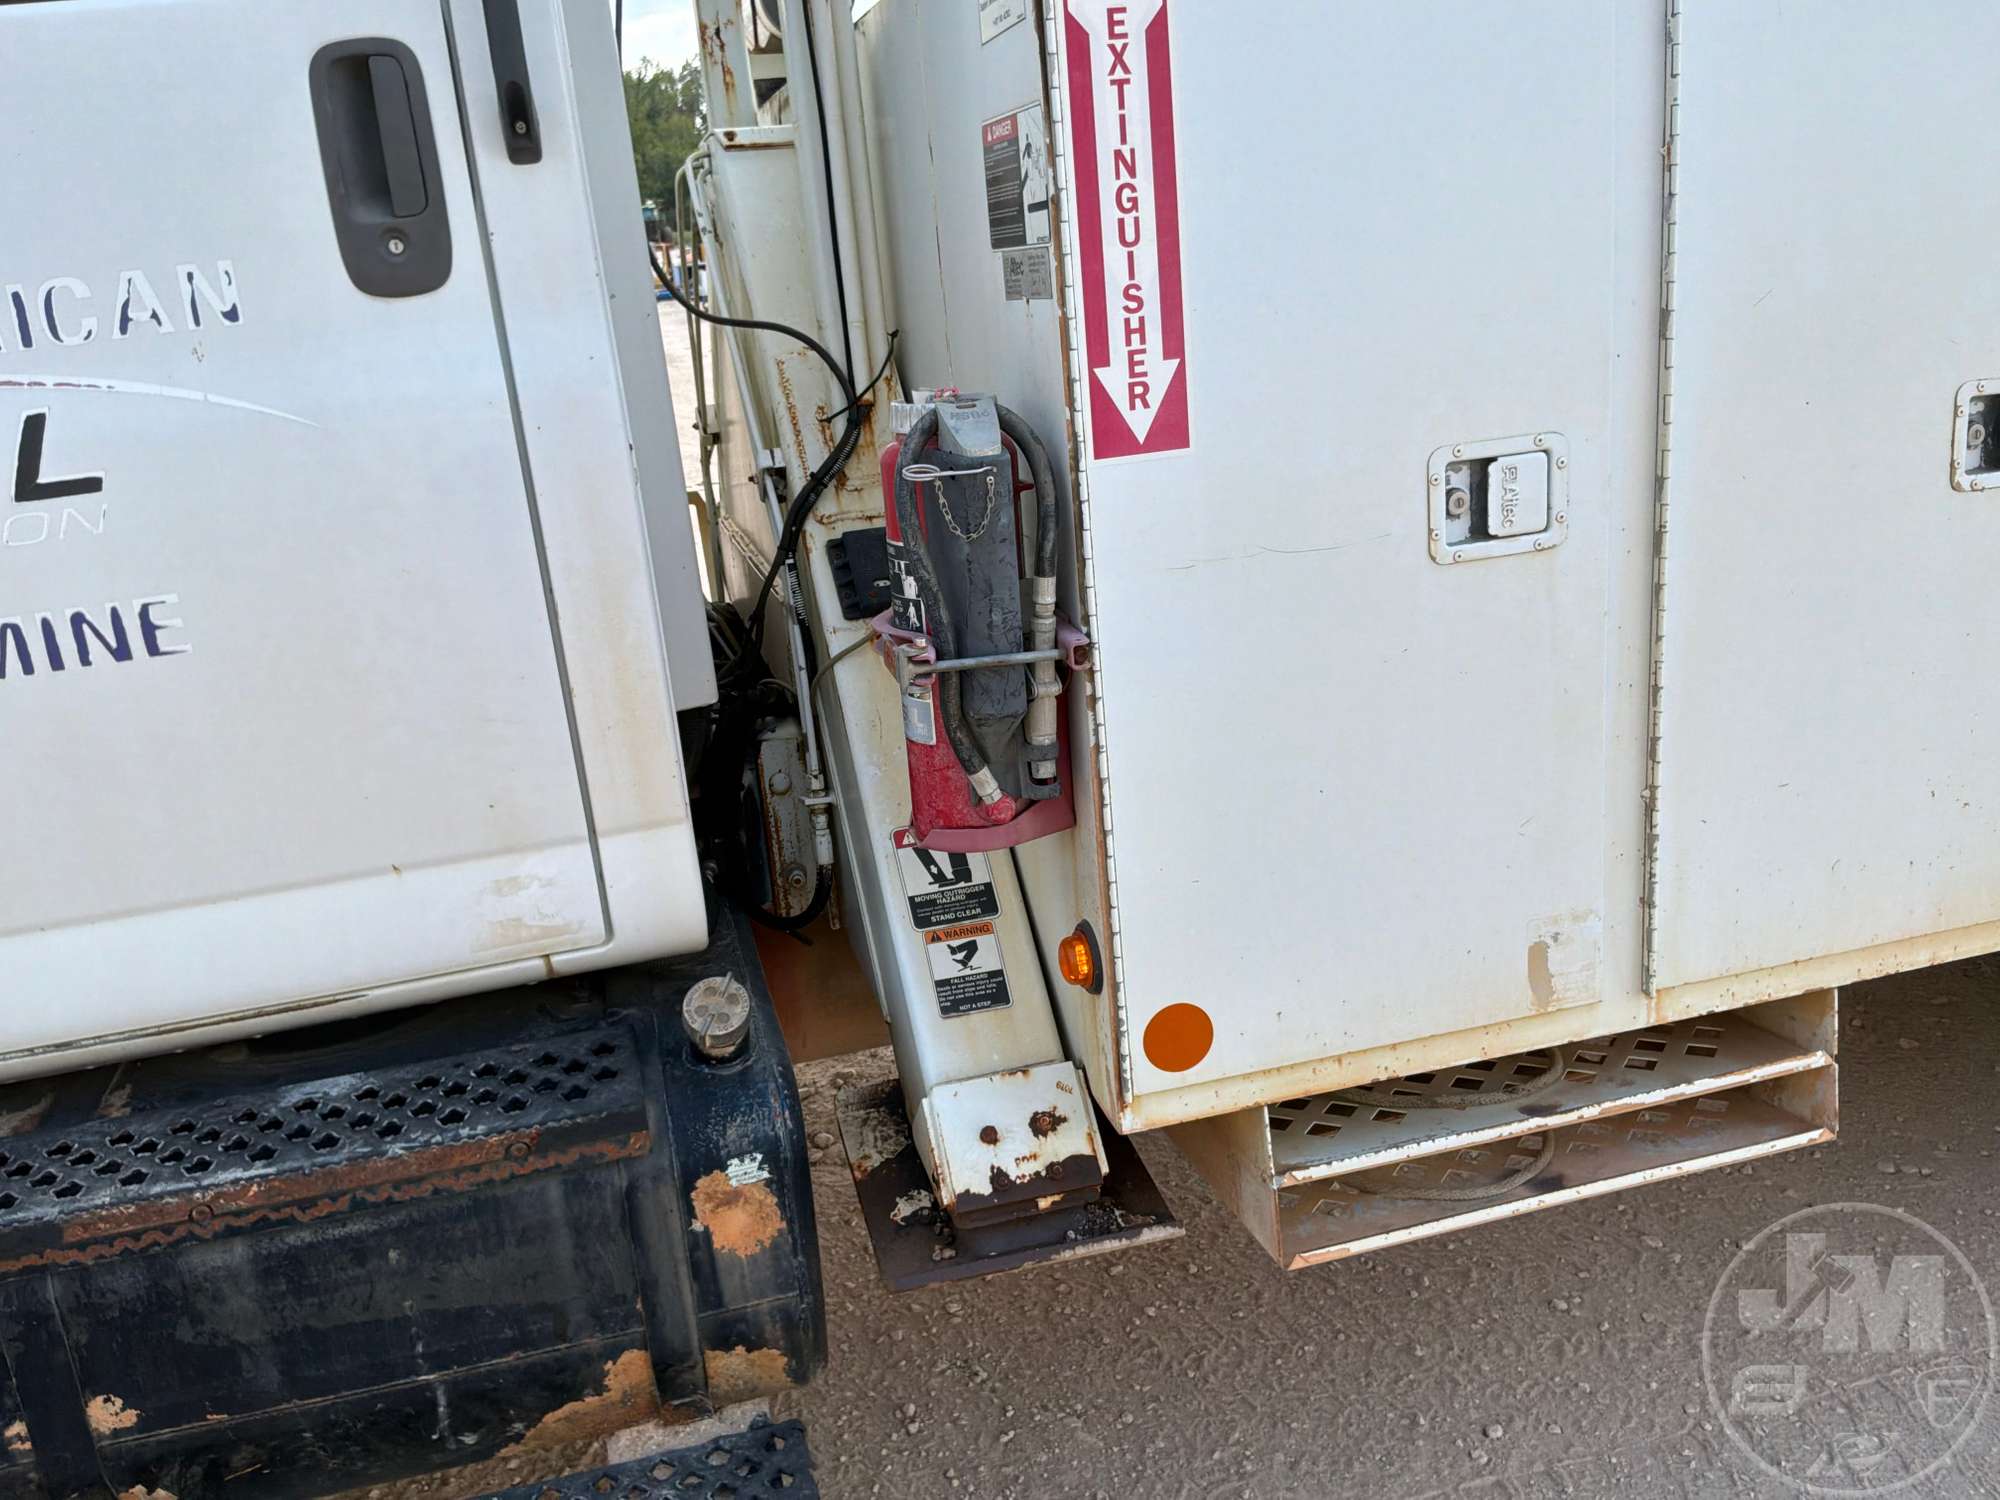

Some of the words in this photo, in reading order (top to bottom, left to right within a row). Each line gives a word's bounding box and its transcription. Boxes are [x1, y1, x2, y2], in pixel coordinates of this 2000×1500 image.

[1106, 7, 1151, 411] EXTINGUISHER
[0, 259, 243, 352] ICAN
[914, 892, 943, 903] MOVING
[944, 886, 985, 898] OUTRIGGER
[936, 894, 966, 904] HAZARD
[930, 912, 956, 922] STAND
[956, 908, 982, 918] CLEAR
[943, 924, 990, 939] WARNING
